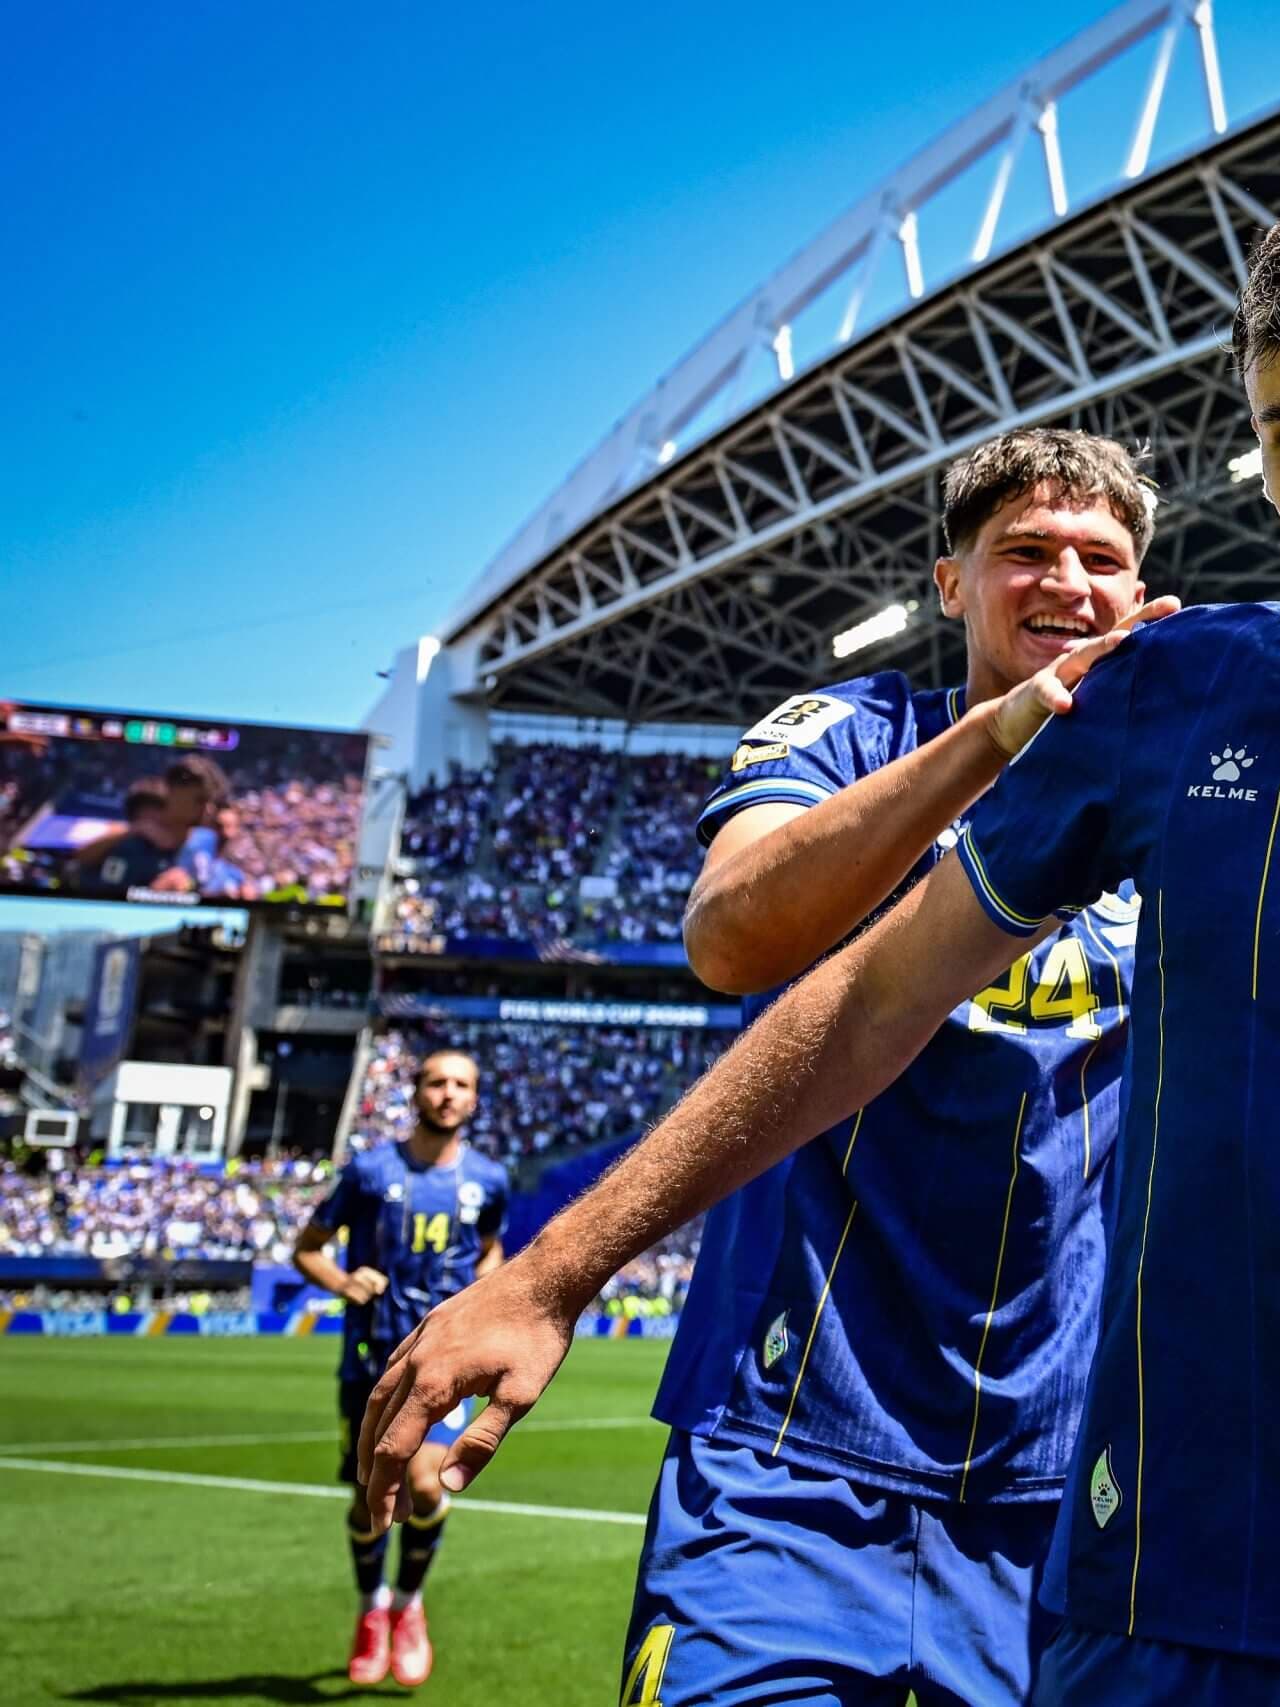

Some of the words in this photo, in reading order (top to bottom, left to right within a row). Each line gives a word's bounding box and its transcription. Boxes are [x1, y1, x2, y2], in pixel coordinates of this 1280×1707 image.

[1187, 785, 1258, 801] KELME
[968, 937, 1102, 1040] 24
[411, 1212, 449, 1254] 14
